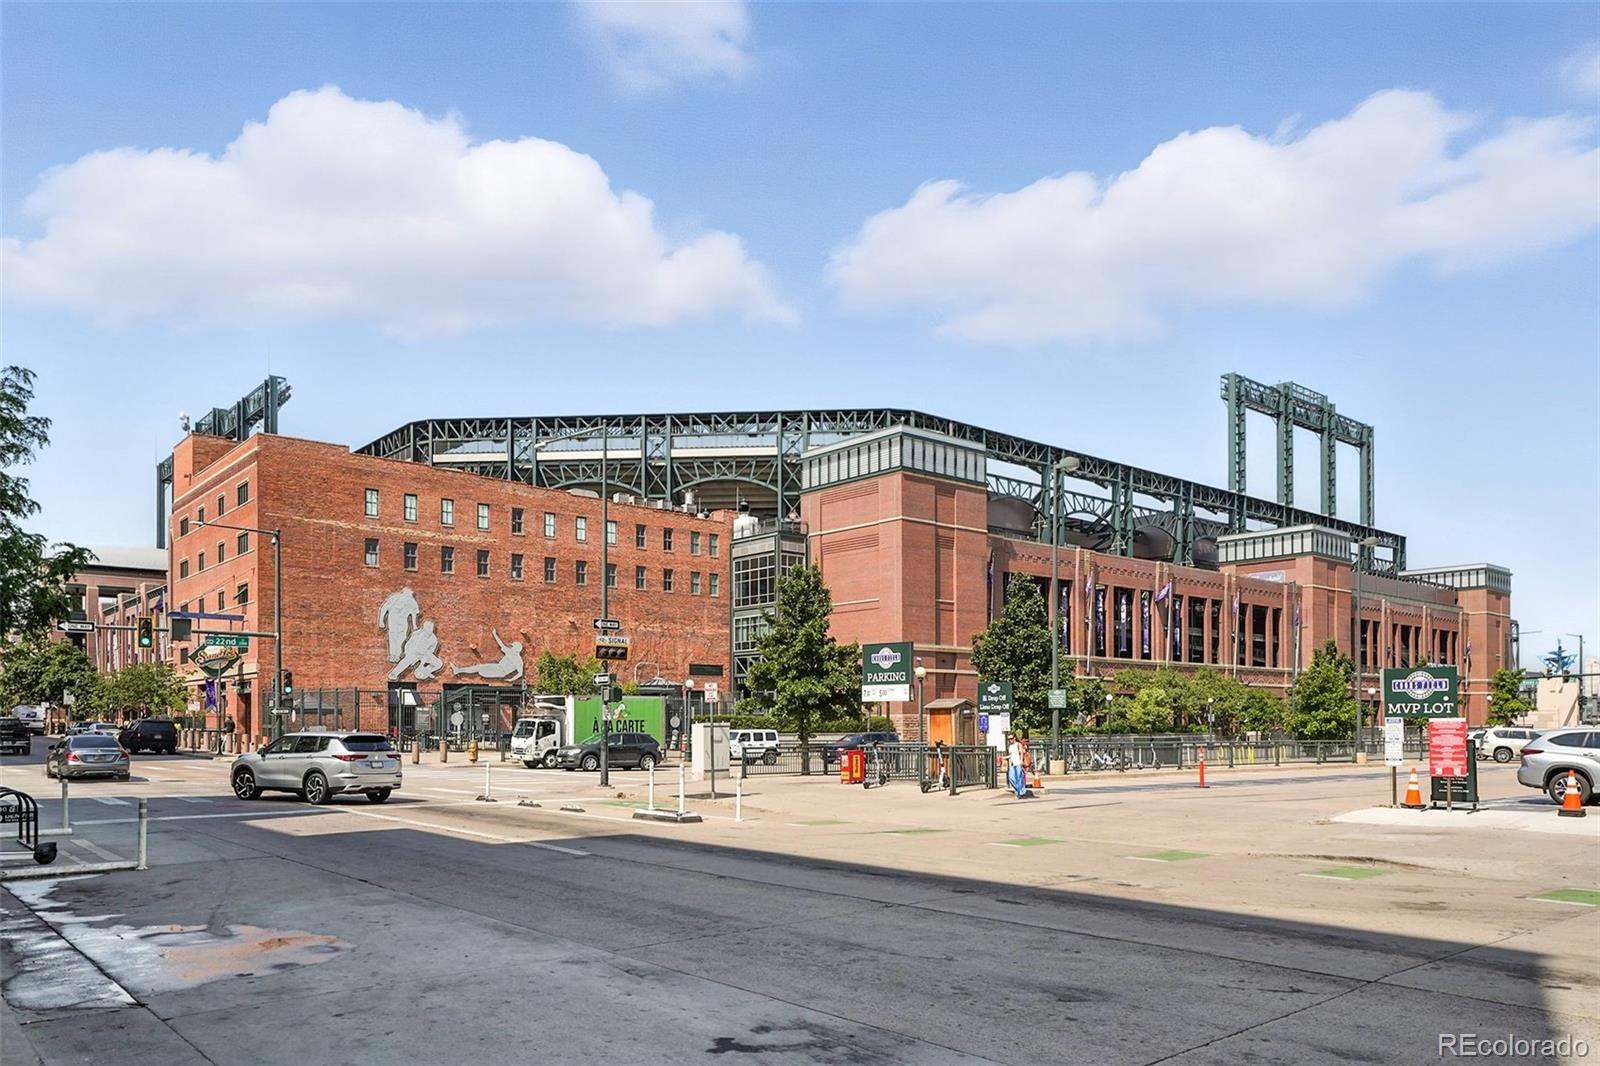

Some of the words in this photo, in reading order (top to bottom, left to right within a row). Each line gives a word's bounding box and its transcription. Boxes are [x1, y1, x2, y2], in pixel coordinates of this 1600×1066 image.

[215, 637, 237, 645] 22nd
[608, 637, 628, 645] SIGNAL
[867, 671, 906, 682] PARKING
[1388, 703, 1421, 714] MVP
[1423, 702, 1454, 714] LOT
[593, 716, 599, 733] À
[616, 719, 645, 733] CARTE
